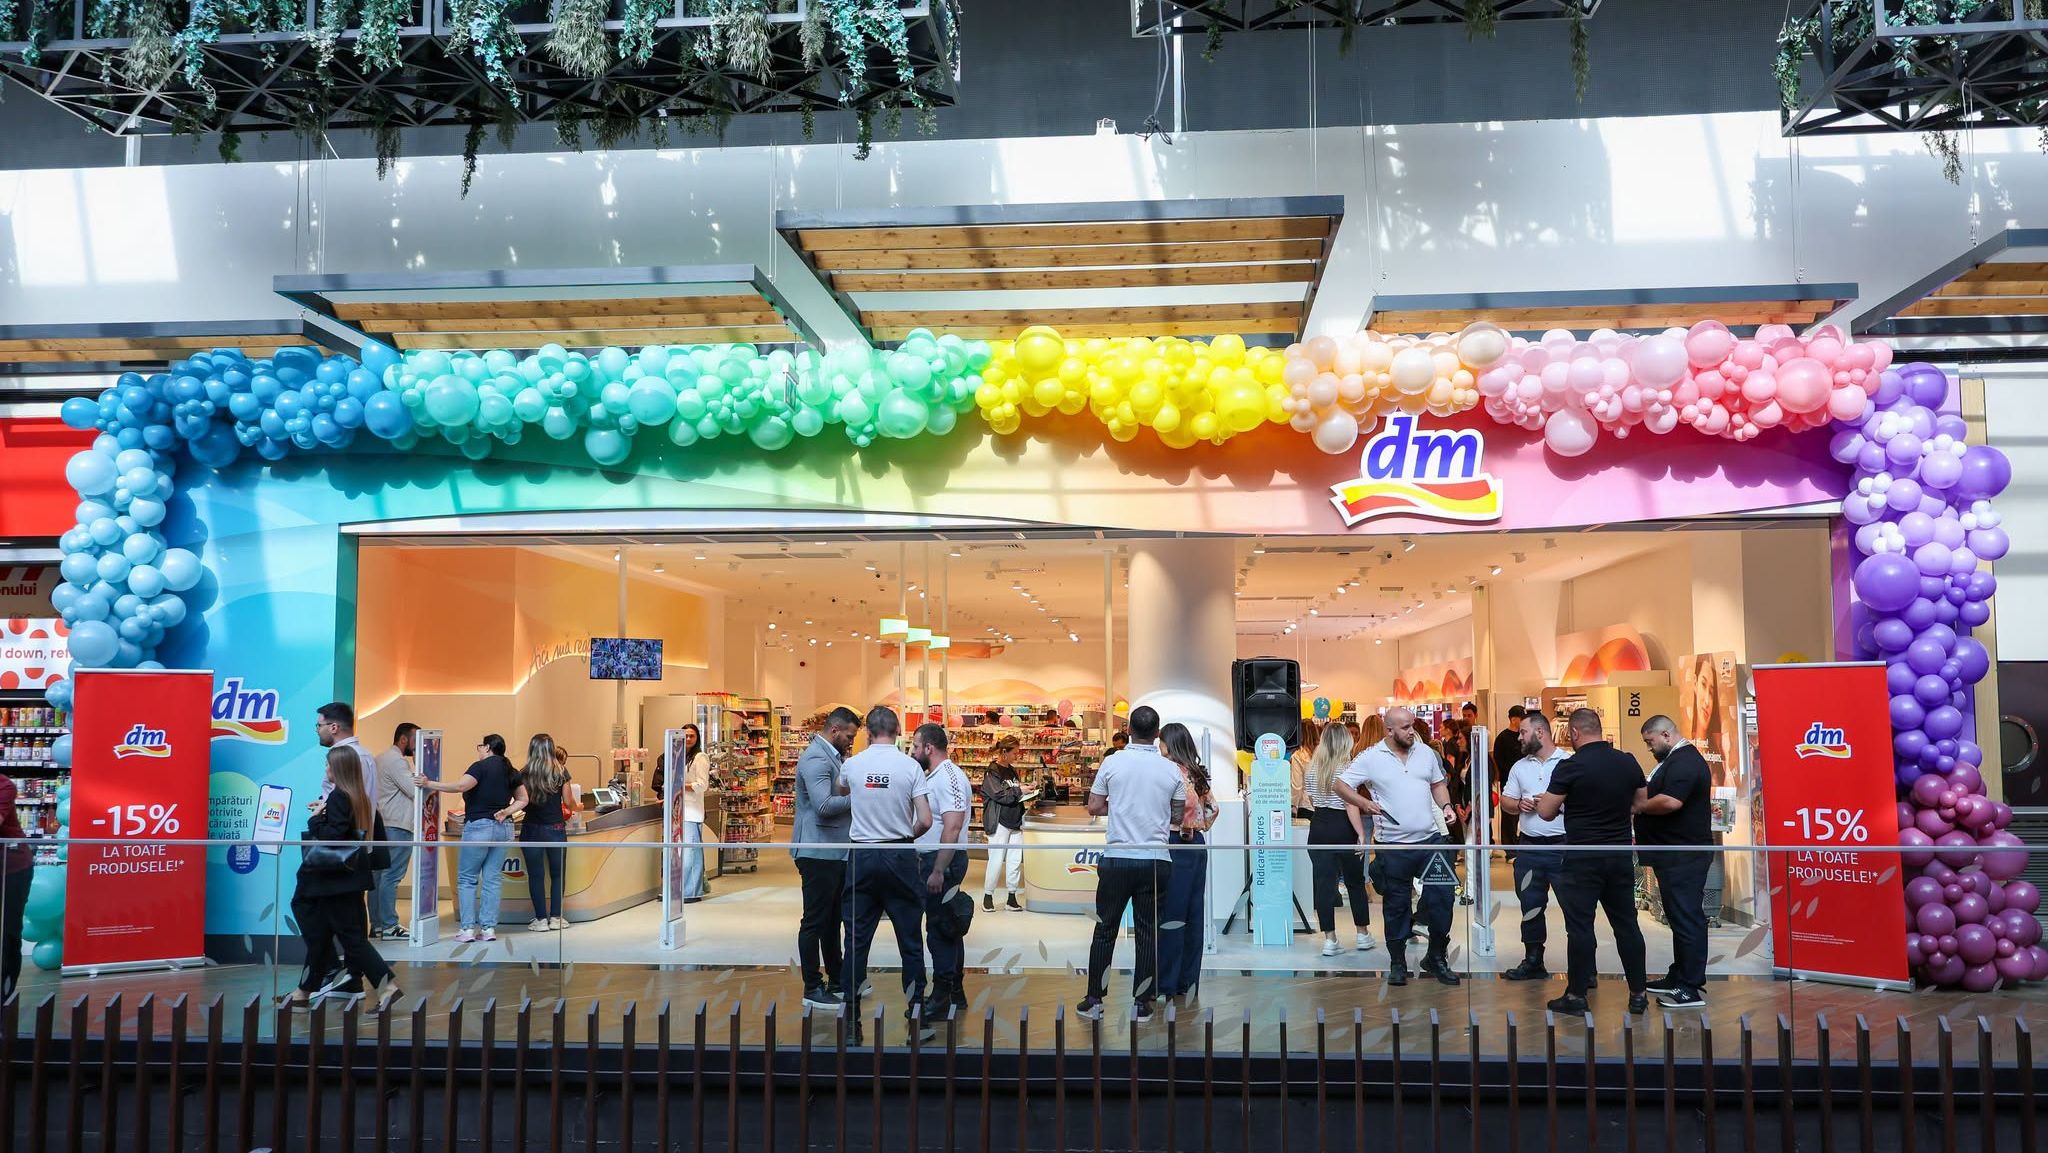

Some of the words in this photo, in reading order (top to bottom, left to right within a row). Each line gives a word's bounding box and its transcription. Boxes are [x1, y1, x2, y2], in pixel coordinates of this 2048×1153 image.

[1367, 416, 1478, 480] dm
[0, 583, 37, 595] nului
[5, 648, 47, 660] down,
[212, 680, 276, 720] dm
[1627, 692, 1641, 717] Box
[126, 725, 164, 745] dm
[1806, 724, 1842, 745] dm
[866, 775, 890, 784] SSG
[92, 803, 180, 836] -15%
[208, 808, 243, 817] otrivite
[266, 808, 280, 817] dm
[234, 819, 248, 828] stil
[1255, 816, 1266, 846] Expres
[1783, 807, 1868, 842] -15%
[103, 846, 120, 858] LA
[124, 844, 167, 857] TOATE
[1797, 850, 1814, 862] LA
[1816, 850, 1859, 865] TOATE
[1256, 849, 1265, 886] Ridicare
